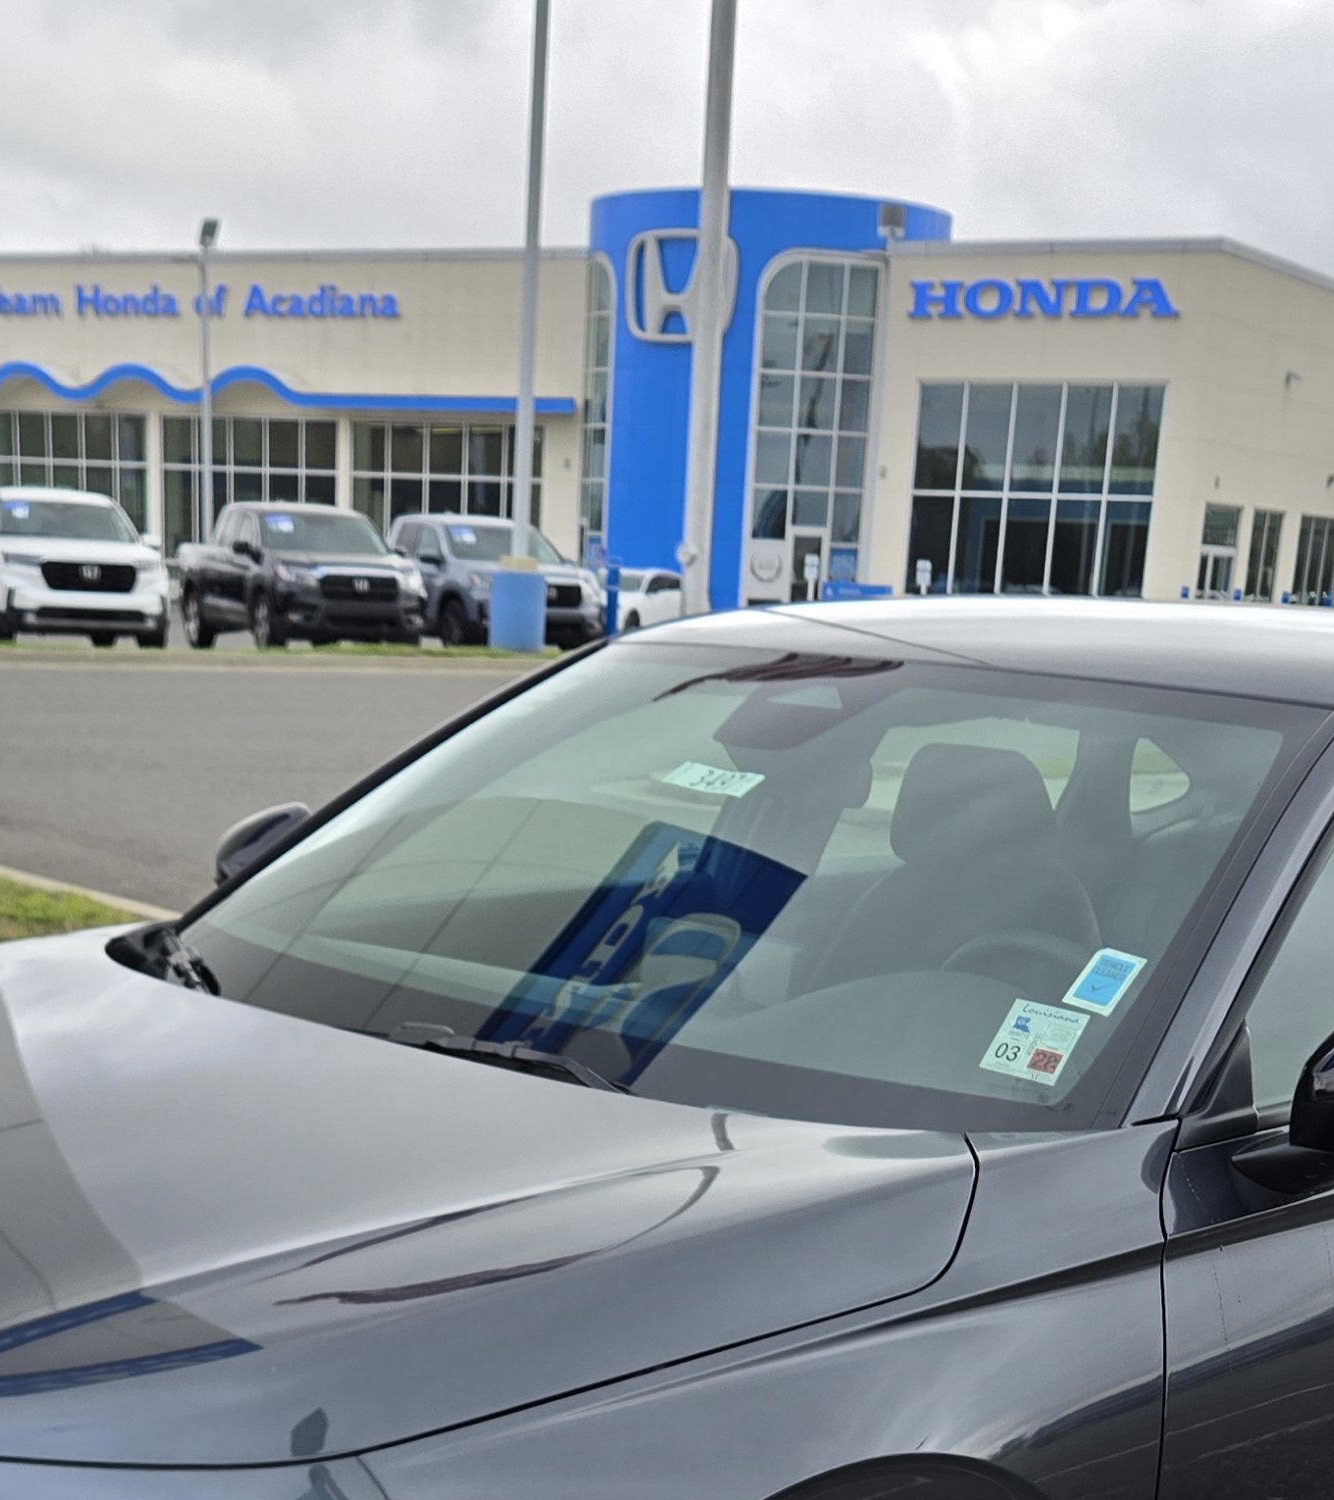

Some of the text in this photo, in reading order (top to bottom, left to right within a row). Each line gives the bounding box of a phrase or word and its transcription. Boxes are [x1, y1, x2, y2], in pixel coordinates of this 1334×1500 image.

[76, 283, 179, 318] Honda
[244, 283, 399, 318] Acadiana
[907, 277, 1180, 319] HONDA
[1022, 1002, 1080, 1024] Louisiana
[995, 1042, 1021, 1062] 03
